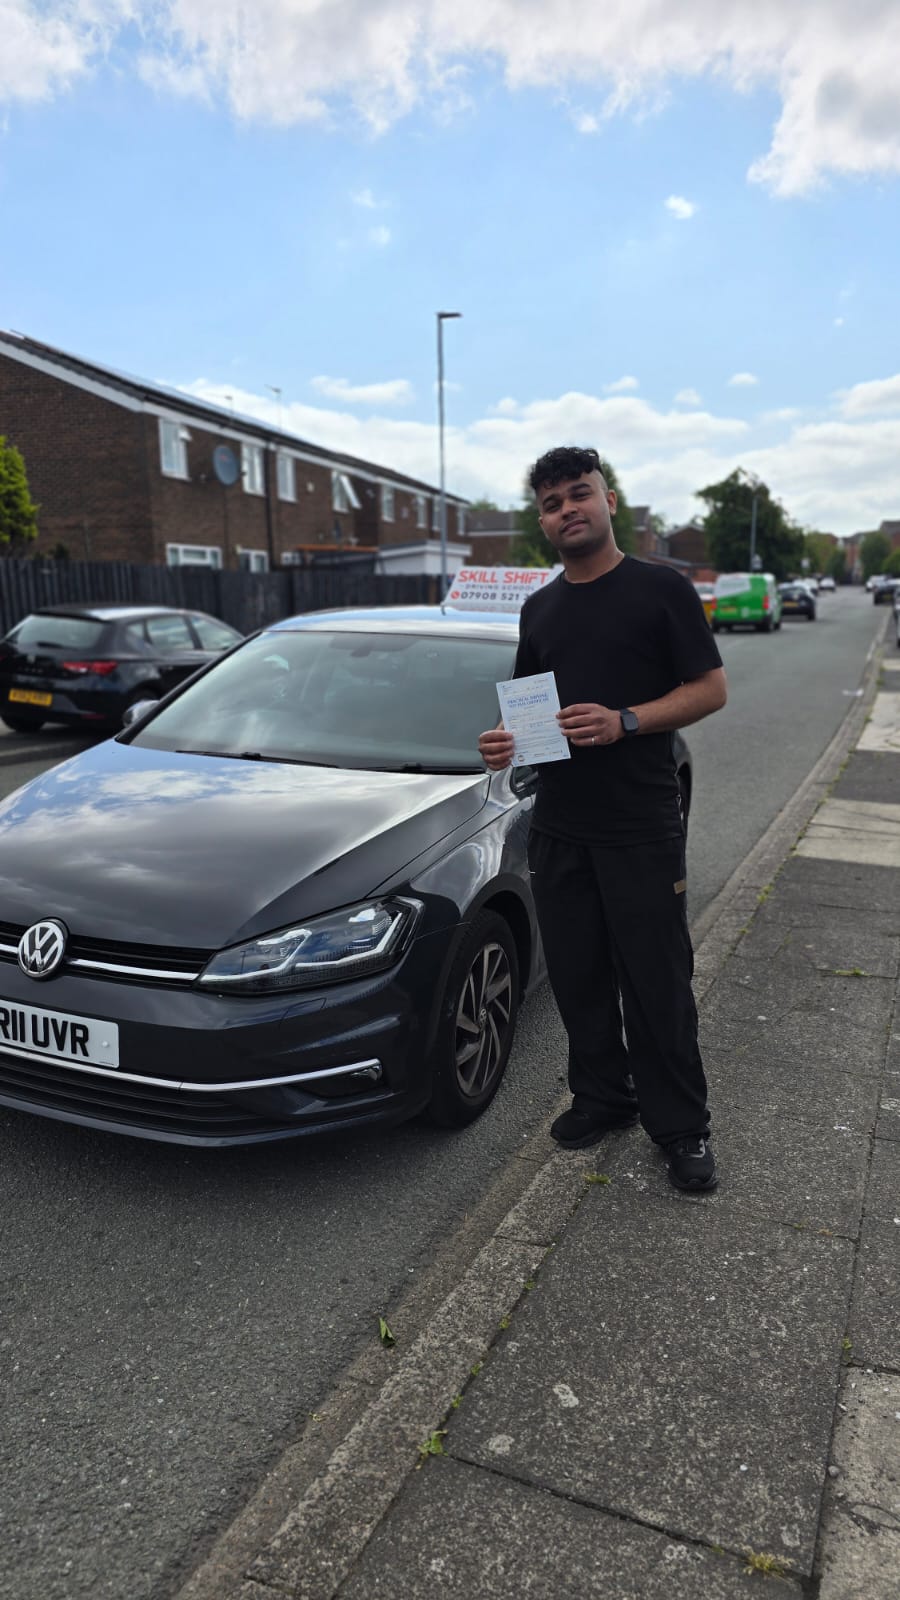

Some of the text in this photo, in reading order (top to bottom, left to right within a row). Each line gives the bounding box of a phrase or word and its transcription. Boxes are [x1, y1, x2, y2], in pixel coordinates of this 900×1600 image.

[457, 570, 549, 585] SKILL SHIFT
[460, 591, 497, 600] 07908
[501, 592, 520, 601] 521
[31, 1014, 90, 1057] UVR
